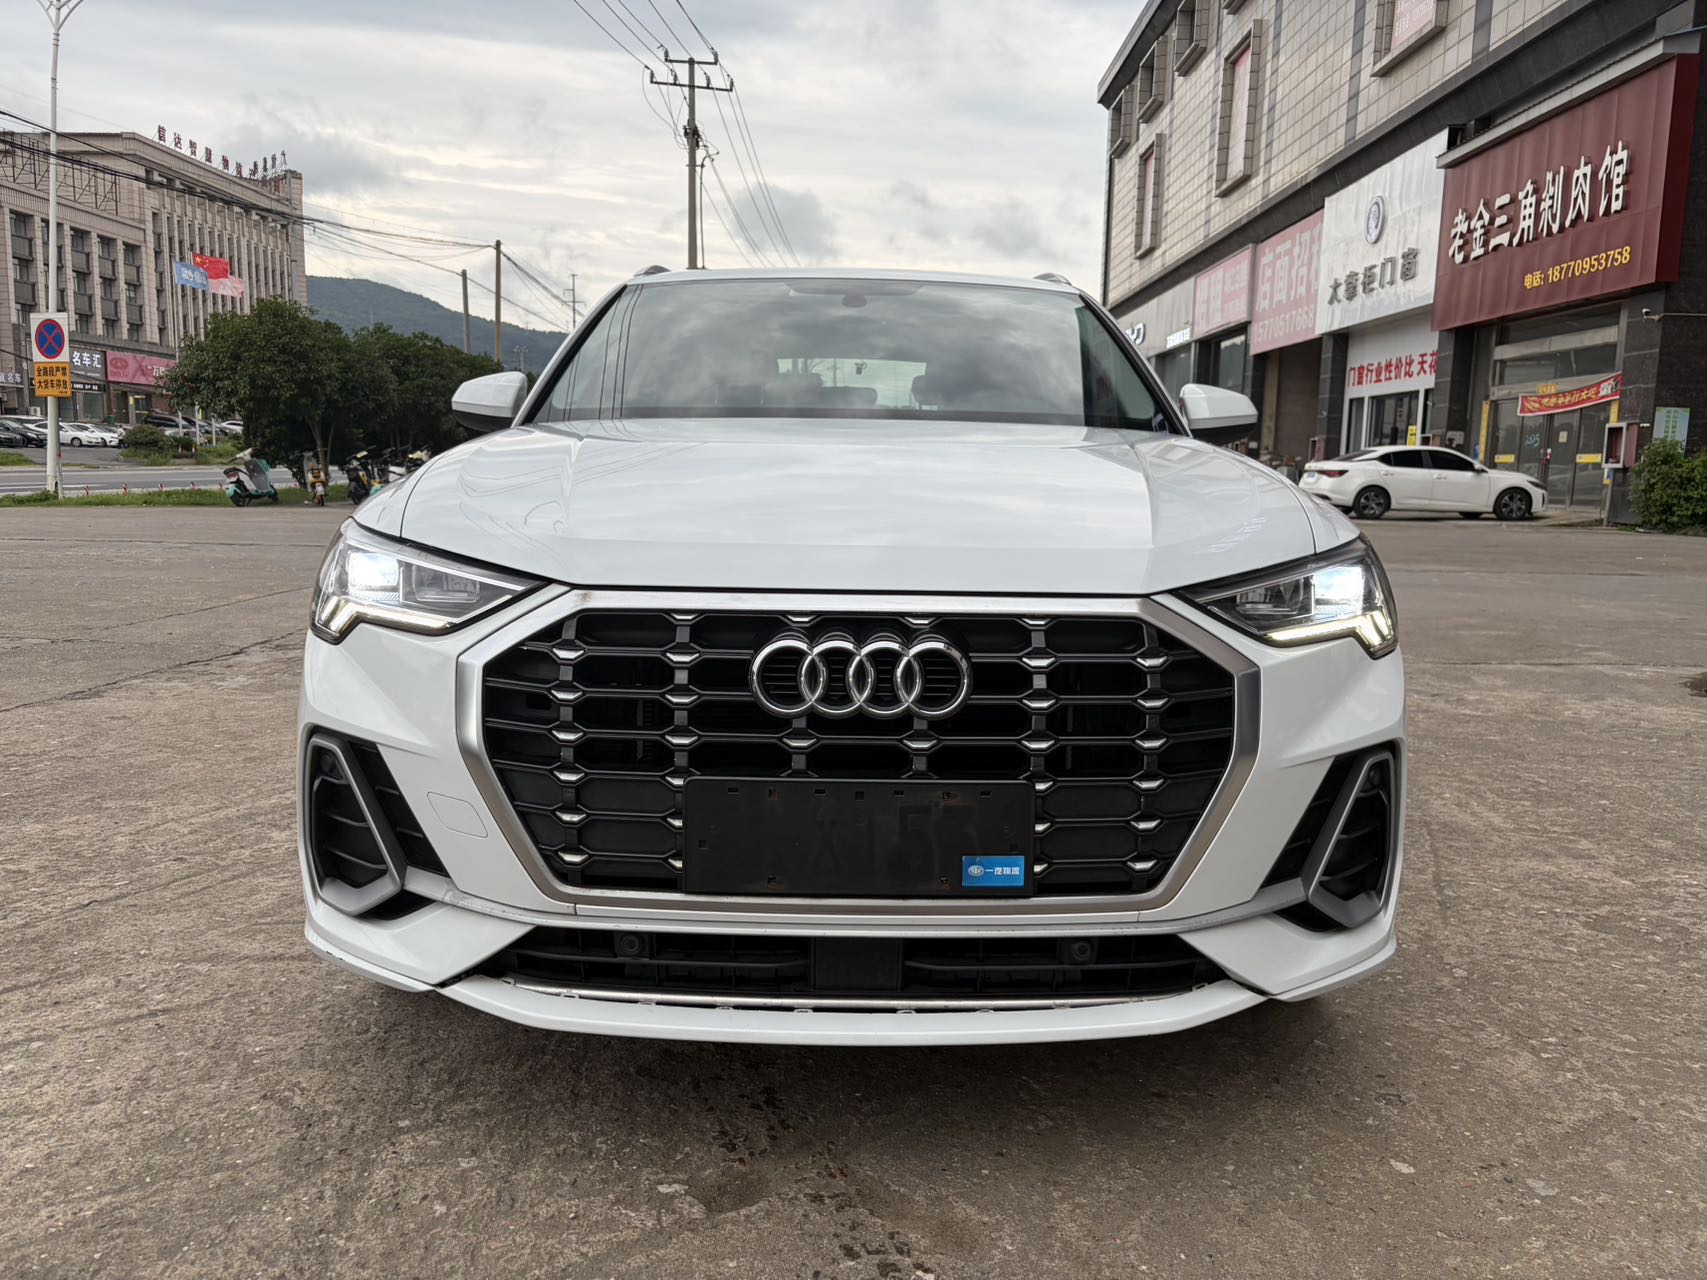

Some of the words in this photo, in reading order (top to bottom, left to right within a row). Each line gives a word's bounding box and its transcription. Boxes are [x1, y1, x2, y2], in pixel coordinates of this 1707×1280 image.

[1448, 140, 1628, 265] 老金三角剁肉馆
[1547, 246, 1632, 284] 18770953758
[72, 350, 101, 368] 名车汇
[1347, 354, 1414, 387] 门窗行业性价比
